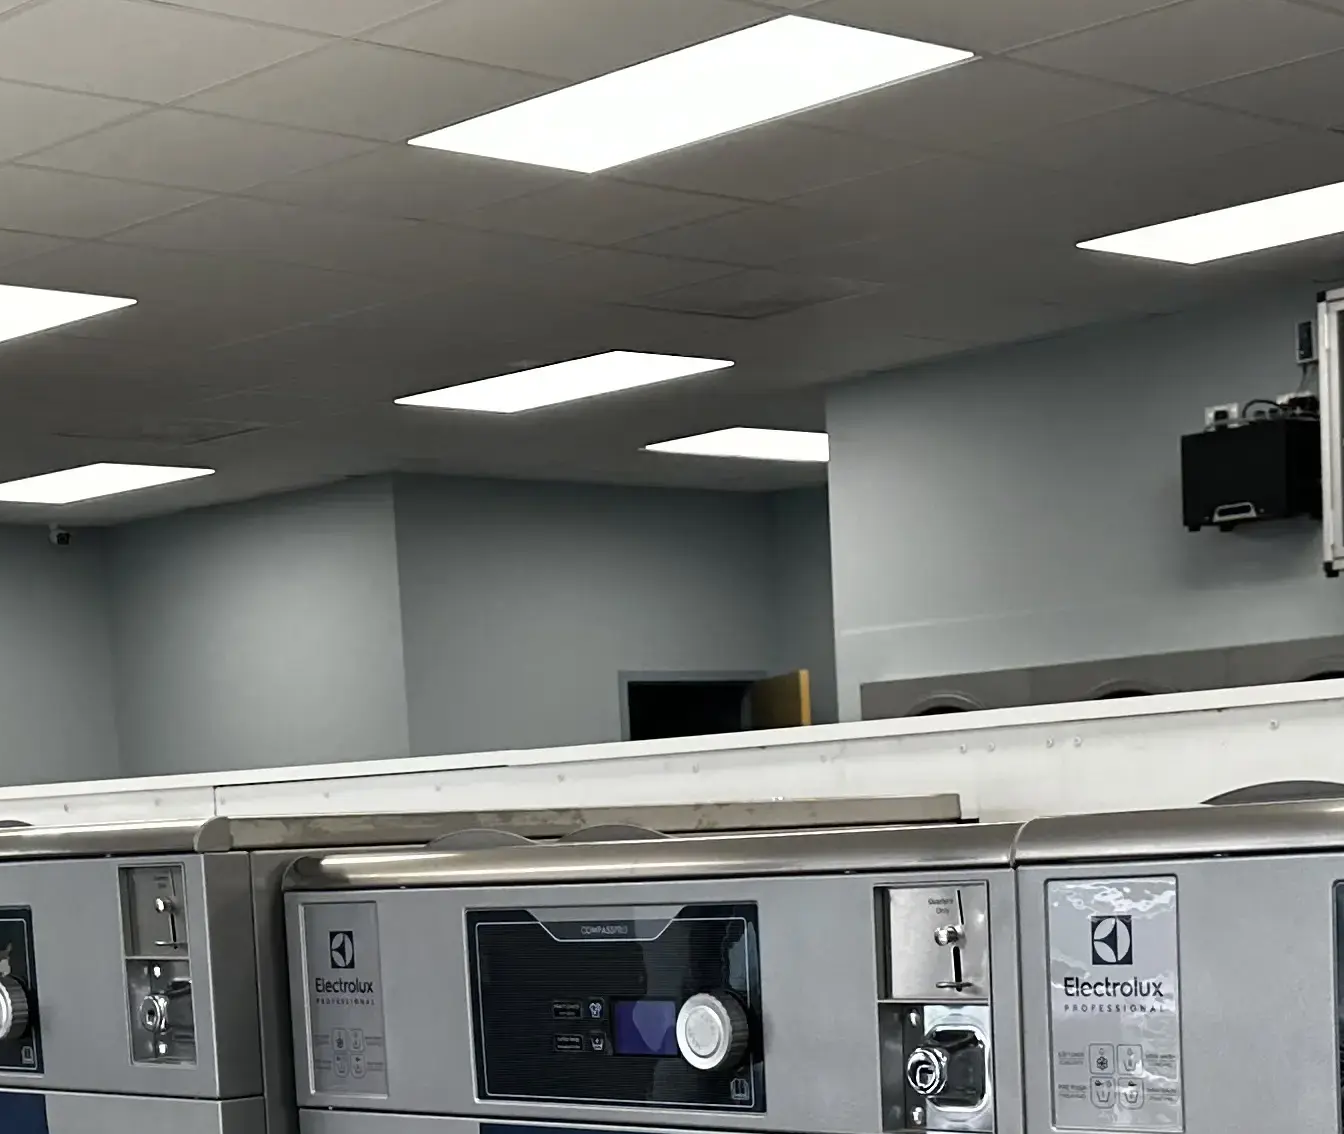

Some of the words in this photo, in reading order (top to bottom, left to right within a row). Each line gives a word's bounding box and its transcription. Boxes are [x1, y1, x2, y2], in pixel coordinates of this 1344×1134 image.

[315, 976, 374, 994] Electrolux
[1064, 976, 1164, 997] Electrolux
[1064, 1004, 1165, 1013] PROFESSIONAL
